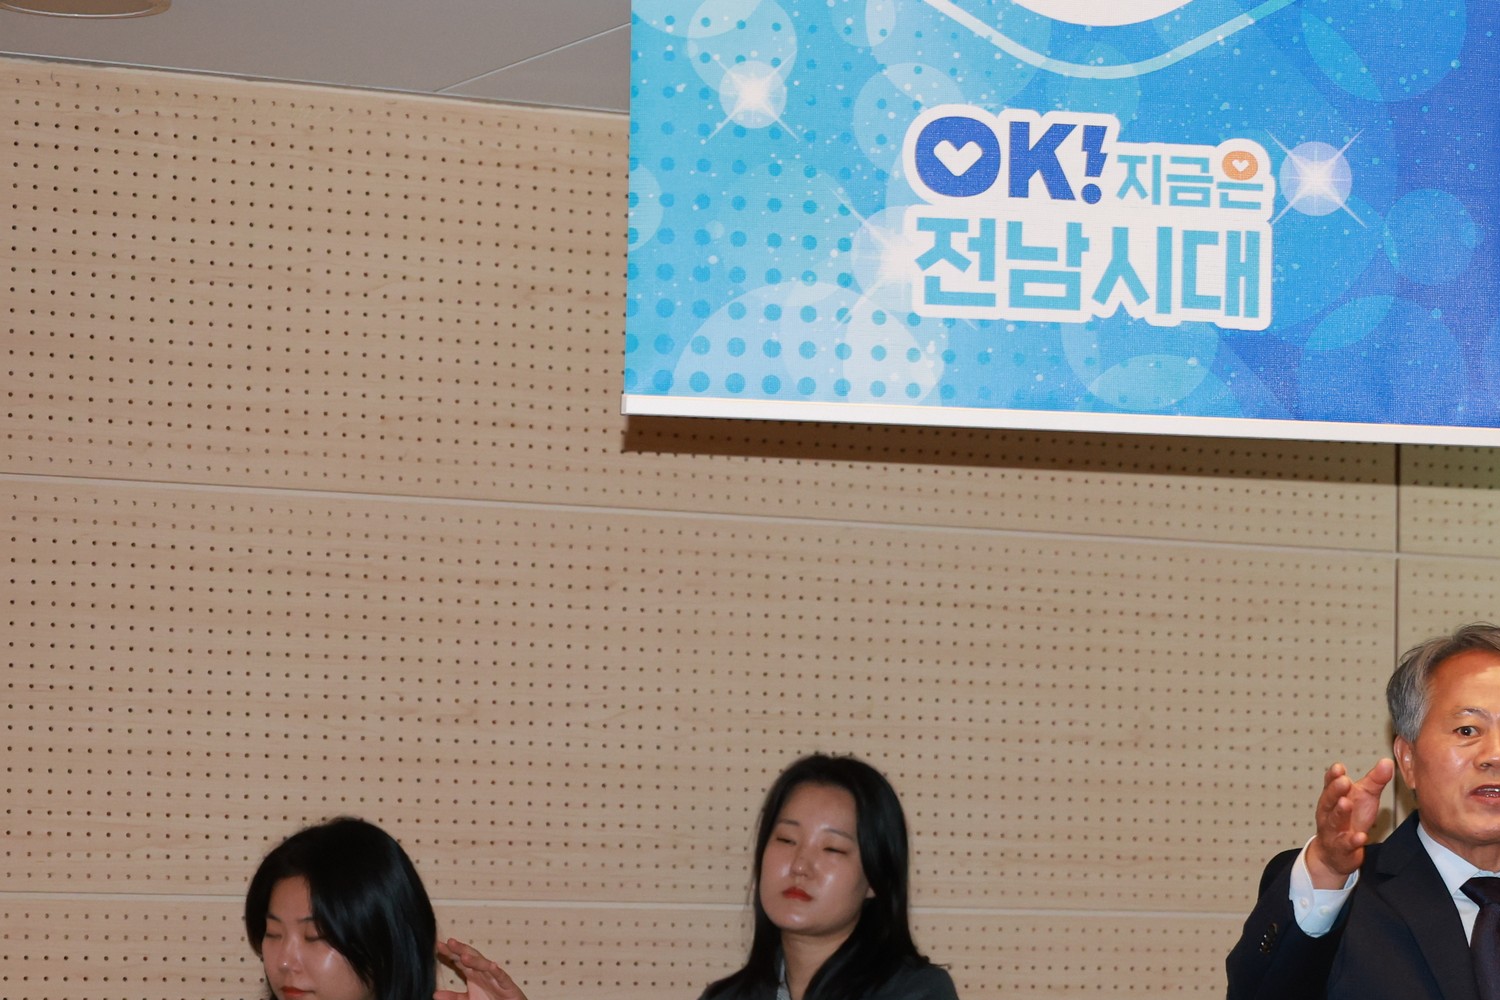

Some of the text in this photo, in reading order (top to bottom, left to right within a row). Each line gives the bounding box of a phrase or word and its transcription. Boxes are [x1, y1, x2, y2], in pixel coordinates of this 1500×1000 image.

[915, 117, 1264, 209] OK! 지금은
[916, 218, 1260, 318] 전남시대
